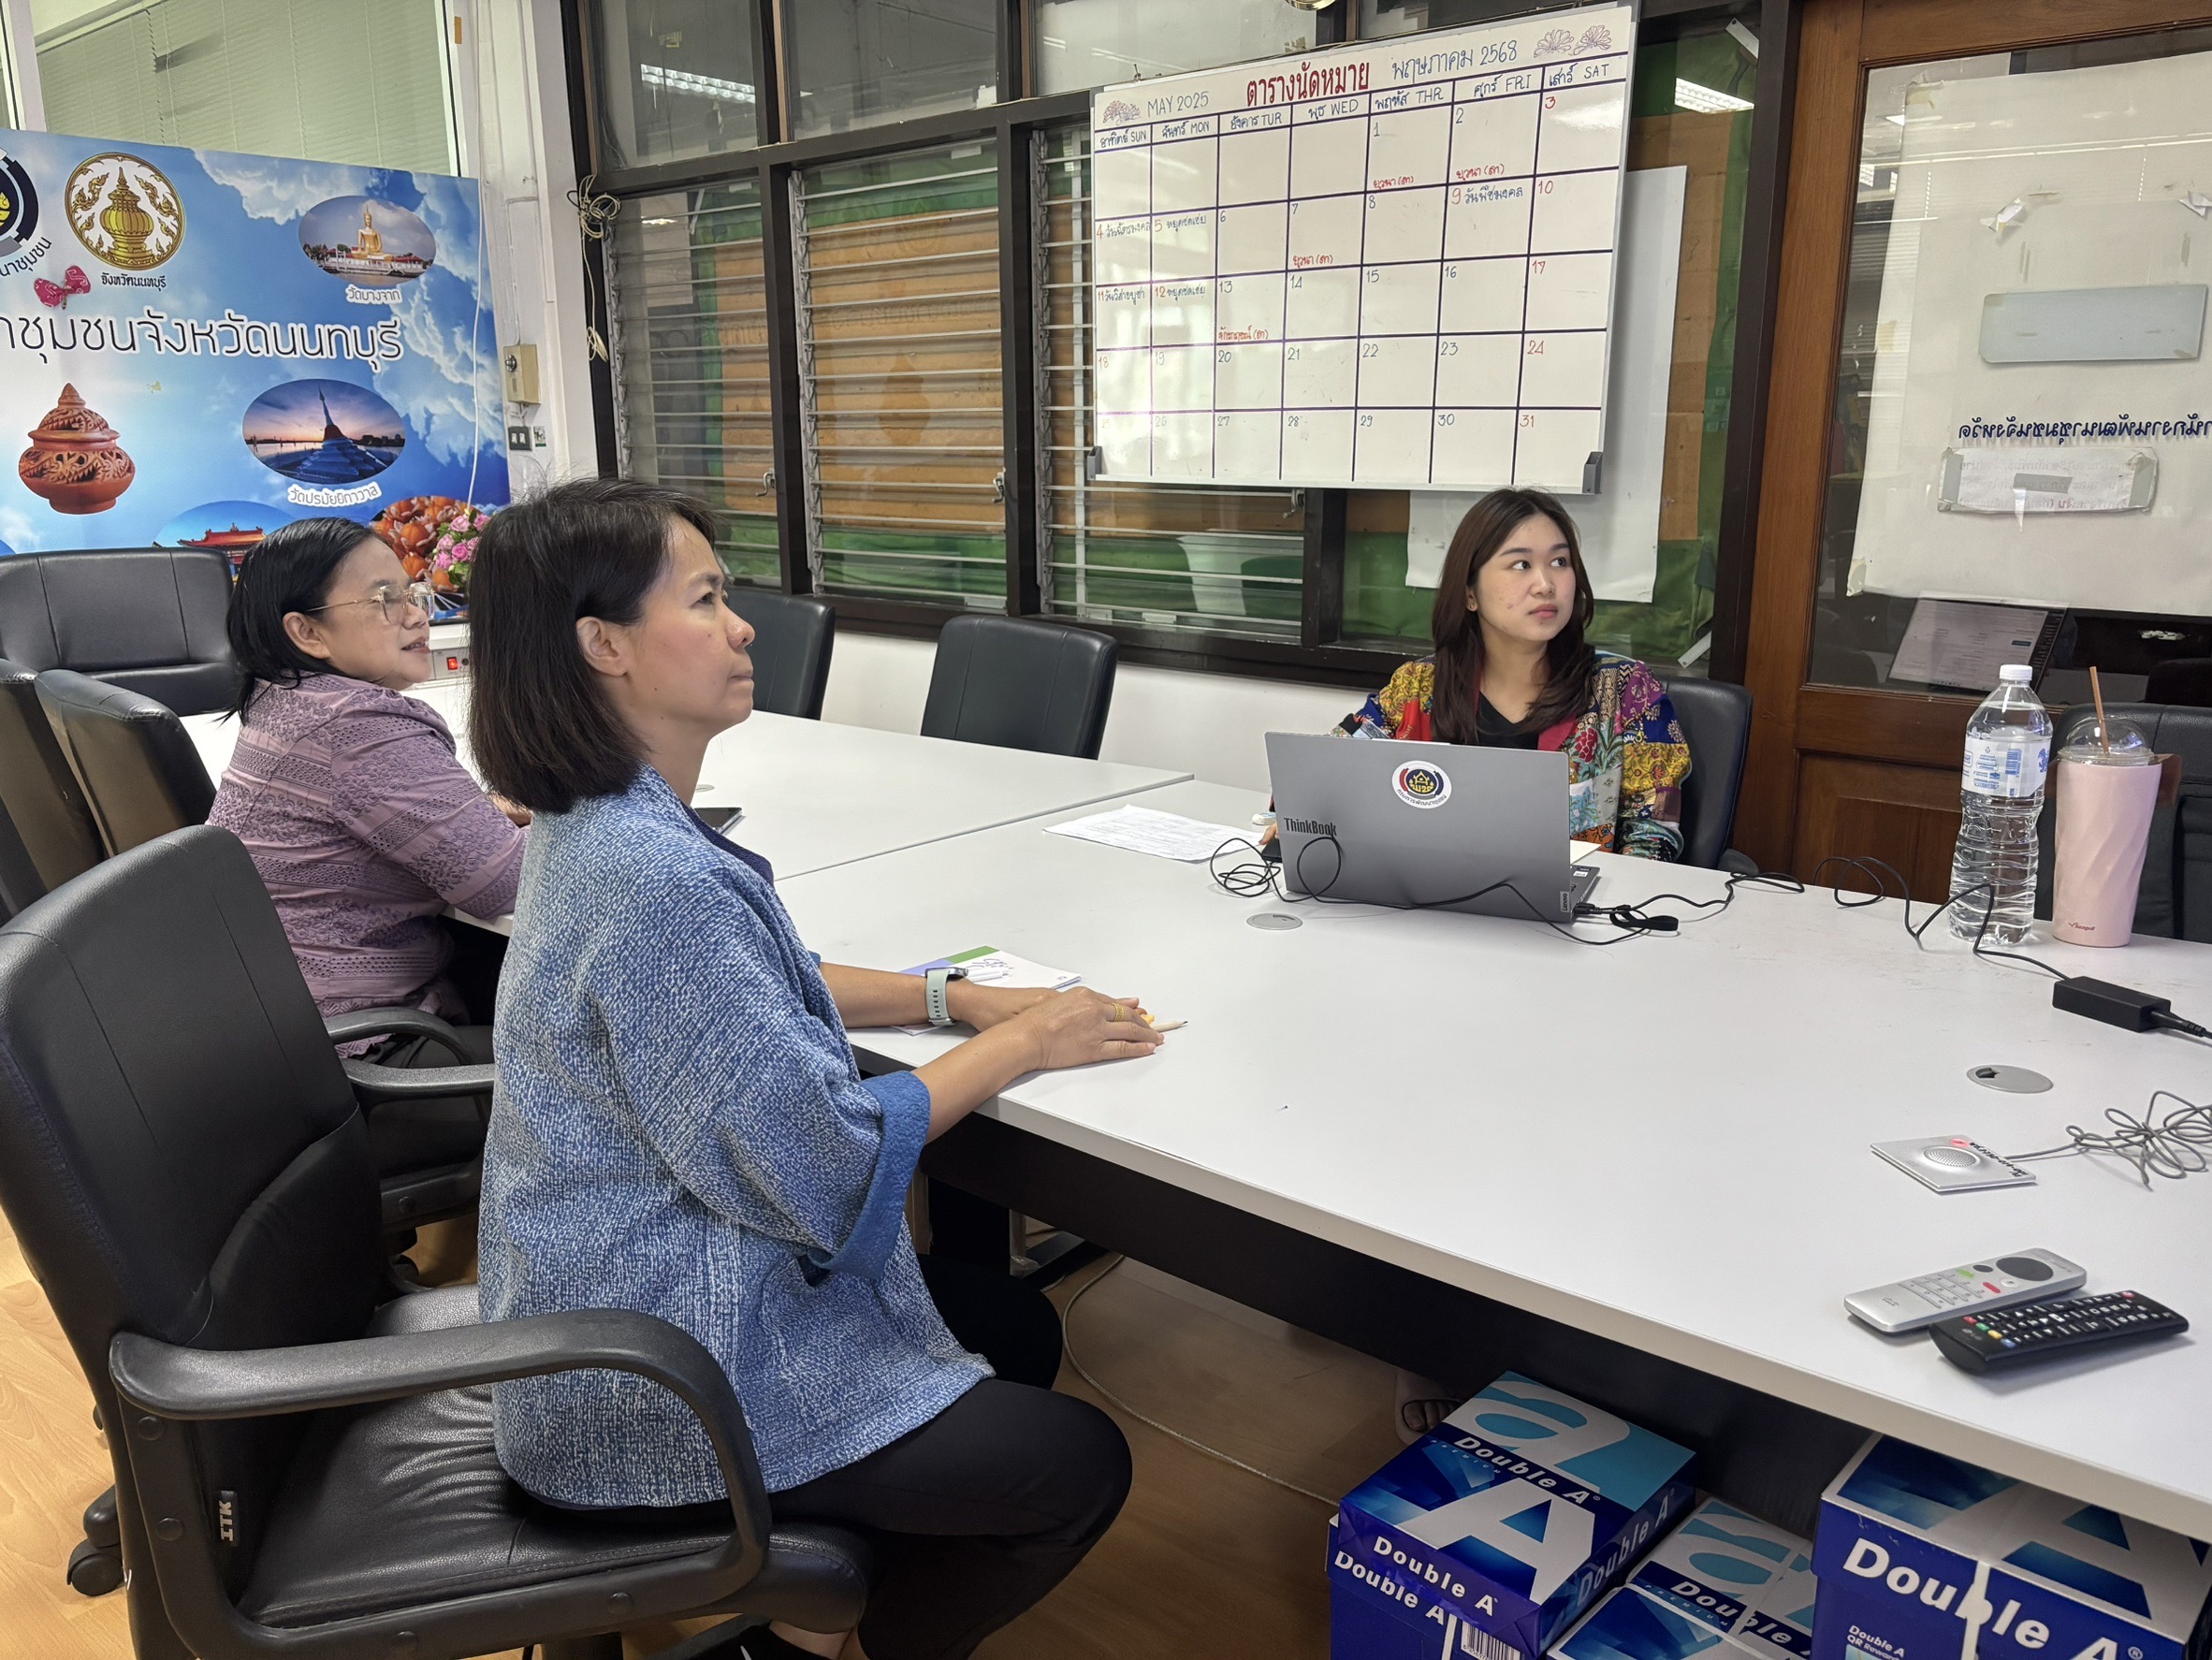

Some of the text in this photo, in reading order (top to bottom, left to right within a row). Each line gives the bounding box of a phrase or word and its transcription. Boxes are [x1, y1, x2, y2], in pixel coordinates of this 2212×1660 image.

[1392, 40, 1518, 84] พฤษภาคม 2568
[1549, 63, 1609, 87] เสาร์ SAT
[1246, 62, 1370, 107] ตารางนัดหมาย
[1474, 75, 1532, 98] ศุกร์ FRI
[1148, 91, 1210, 118] MAY 2025
[1375, 87, 1445, 111] พฤหัส THR
[1545, 96, 1556, 109] 3
[1308, 99, 1359, 121] พุธ WED
[1455, 108, 1464, 124] 2
[1230, 111, 1282, 131] อังคาร TUR
[1161, 121, 1210, 138] จันทร์ MON
[1373, 122, 1380, 138] 1
[1099, 129, 1147, 149] อาทิตย์ SUN
[1538, 181, 1554, 195] 10
[1368, 196, 1376, 210] 8
[1451, 188, 1462, 205] 9
[1291, 203, 1299, 215] 7
[1220, 211, 1226, 223] 6
[1097, 225, 1104, 240] 4
[1154, 219, 1163, 232] 5
[1445, 266, 1457, 279] 16
[1532, 260, 1546, 274] 17
[101, 271, 167, 292] จังหวัดนนทบุรี
[1290, 274, 1302, 289] 14
[1366, 269, 1380, 283] 15
[348, 286, 400, 302] วัดบางจาก
[1155, 286, 1166, 298] 12
[1219, 281, 1233, 294] 13
[1098, 291, 1104, 301] 11
[1288, 347, 1300, 360] 21
[1362, 343, 1379, 357] 22
[1440, 342, 1459, 356] 23
[1527, 340, 1545, 355] 24
[1098, 357, 1109, 369] 18
[1155, 351, 1165, 366] 19
[1218, 350, 1232, 363] 20
[1156, 415, 1168, 427] 26
[1217, 416, 1230, 427] 27
[1288, 416, 1299, 427] 28
[1361, 415, 1373, 427] 29
[1437, 414, 1455, 426] 30
[1520, 415, 1535, 428] 31
[291, 486, 379, 505] วัดปรมัยยิกาวาส
[1284, 817, 1337, 837] ThinkBook
[1430, 1438, 1502, 1475] PREMIUM
[1454, 1436, 1591, 1505] Double A
[219, 1501, 233, 1541] ITK
[1577, 1495, 1670, 1608] Double A
[1374, 1536, 1495, 1617] Double A
[1333, 1550, 1448, 1626] Double A
[1842, 1536, 2051, 1650] Double
[1644, 1583, 1729, 1626] PREMIUM
[1670, 1580, 1793, 1645] Double
[1847, 1634, 1864, 1647] QR
[1848, 1624, 1905, 1658] Double A
